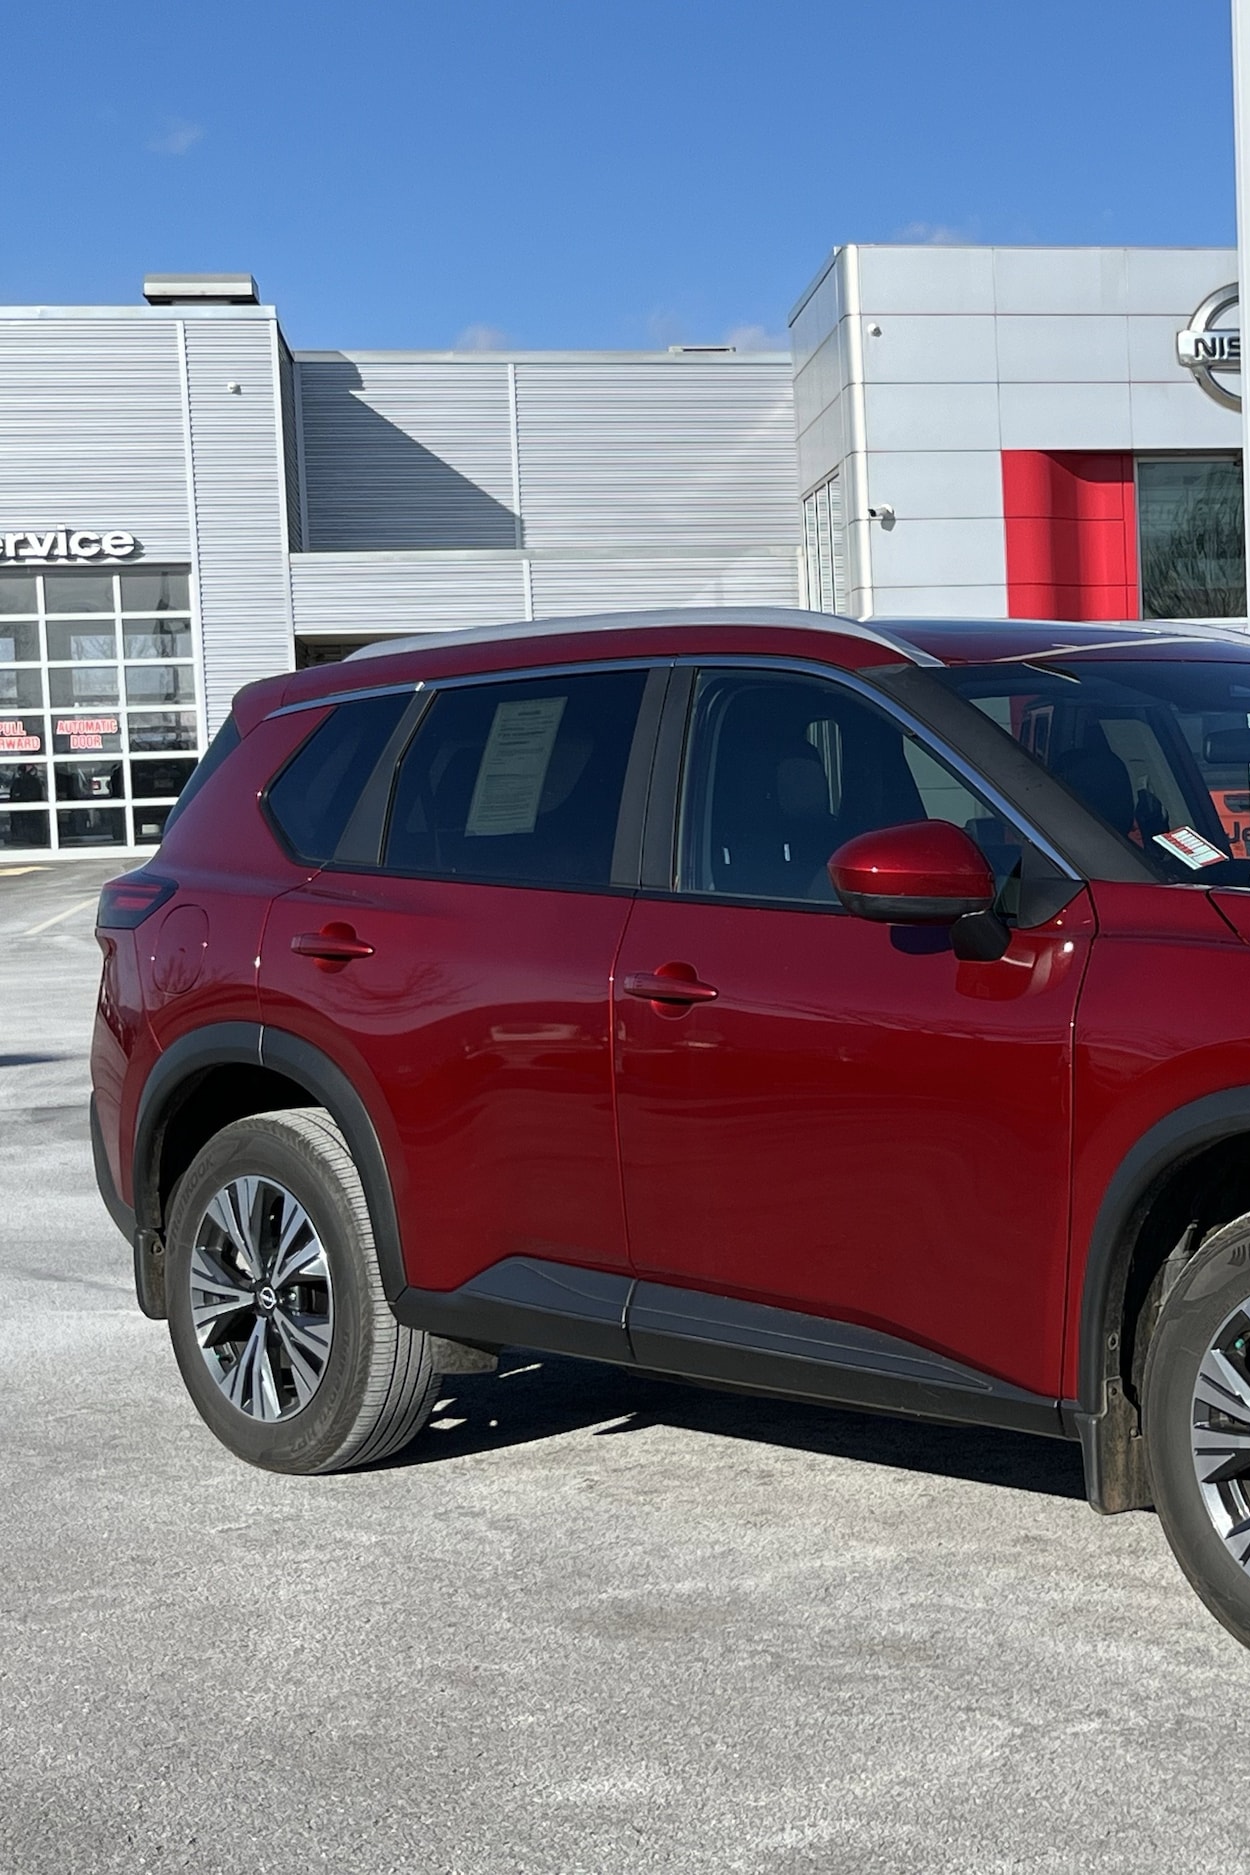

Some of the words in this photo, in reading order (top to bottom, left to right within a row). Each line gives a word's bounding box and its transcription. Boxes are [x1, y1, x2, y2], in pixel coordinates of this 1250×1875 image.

[0, 523, 136, 557] rvice
[57, 719, 118, 734] AUTOMATIC
[71, 735, 102, 749] DOOR
